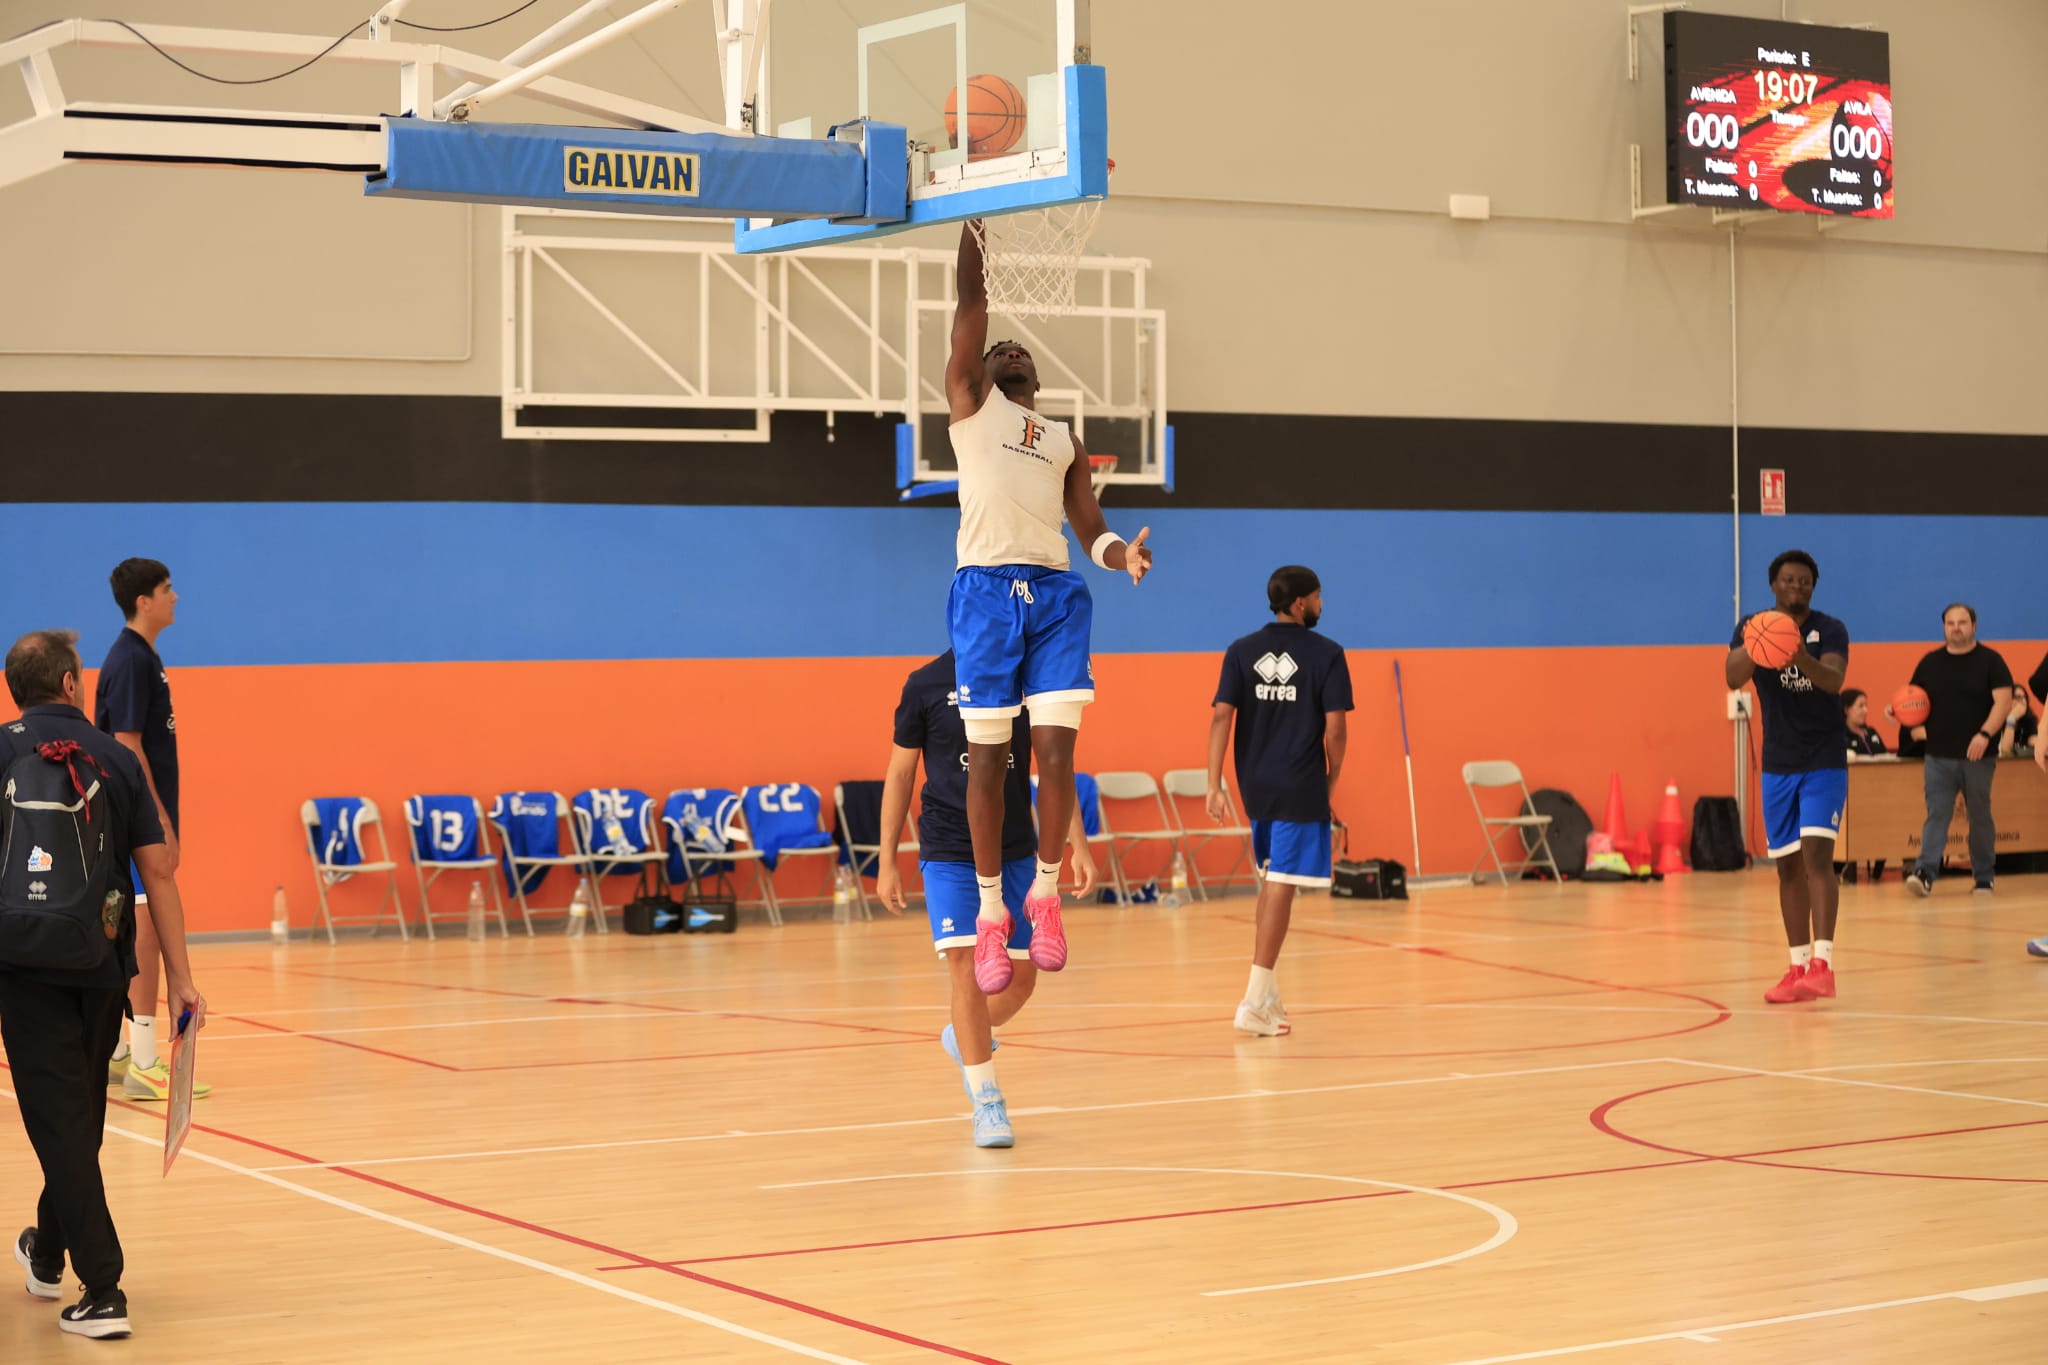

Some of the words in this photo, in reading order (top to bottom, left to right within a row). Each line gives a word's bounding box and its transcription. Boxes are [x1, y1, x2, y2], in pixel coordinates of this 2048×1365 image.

[1802, 51, 1811, 67] E
[1690, 86, 1737, 104] AVENIDA
[1754, 70, 1819, 105] 19:07
[1686, 111, 1740, 150] 000
[1833, 123, 1882, 160] 000
[569, 151, 692, 191] GALVAN
[1748, 159, 1758, 178] 0
[1873, 169, 1882, 187] 0
[1684, 178, 1696, 195] T.
[1749, 182, 1758, 201] 0
[1811, 187, 1822, 203] T.
[1873, 192, 1882, 210] 0
[1019, 415, 1046, 450] F
[1002, 443, 1054, 465] BASKETBALL
[1255, 683, 1297, 701] errea
[430, 808, 463, 852] 13
